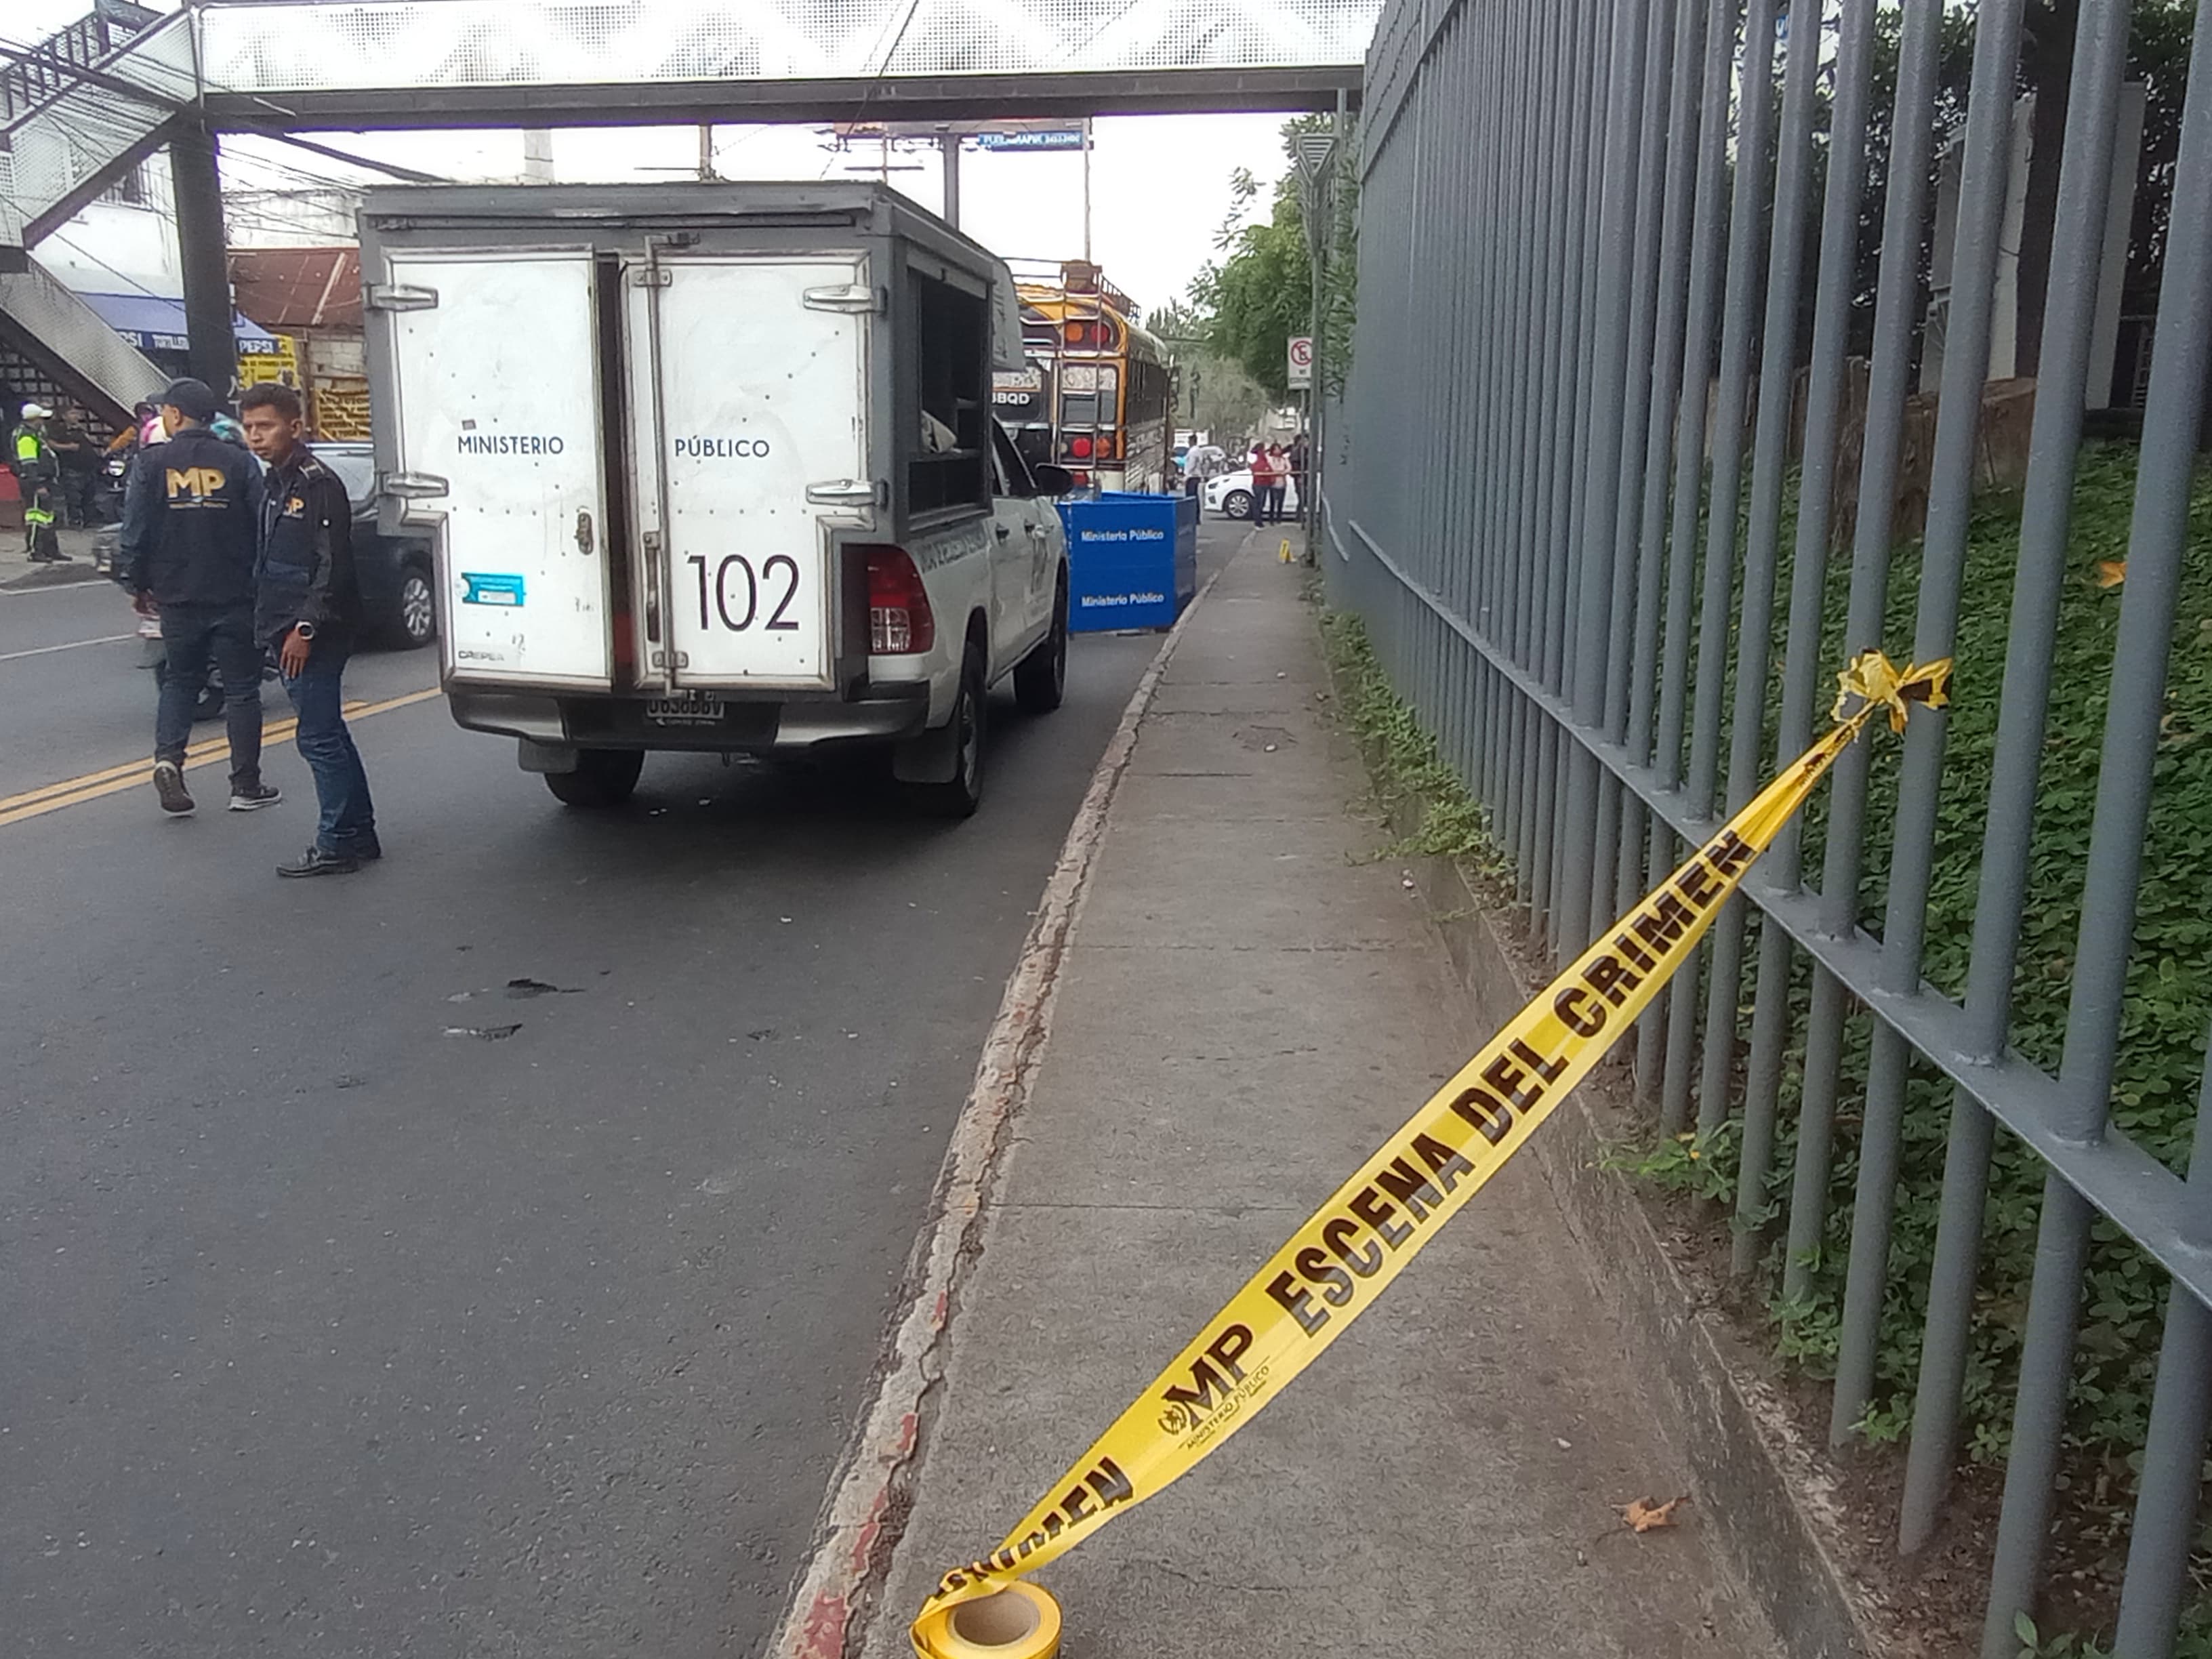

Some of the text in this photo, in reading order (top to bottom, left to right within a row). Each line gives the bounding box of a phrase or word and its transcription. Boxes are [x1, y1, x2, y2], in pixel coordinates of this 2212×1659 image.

[239, 340, 274, 354] PEPSI
[458, 435, 771, 457] MINISTERIO PÚBLICO
[165, 466, 226, 497] MP
[1081, 529, 1164, 543] Ministerio Público
[687, 554, 800, 632] 102
[1081, 592, 1164, 607] Ministerio Público
[1161, 829, 1758, 1431] MP ESCENA DEL CRIMEN
[1187, 1401, 1234, 1450] MINISTERIO
